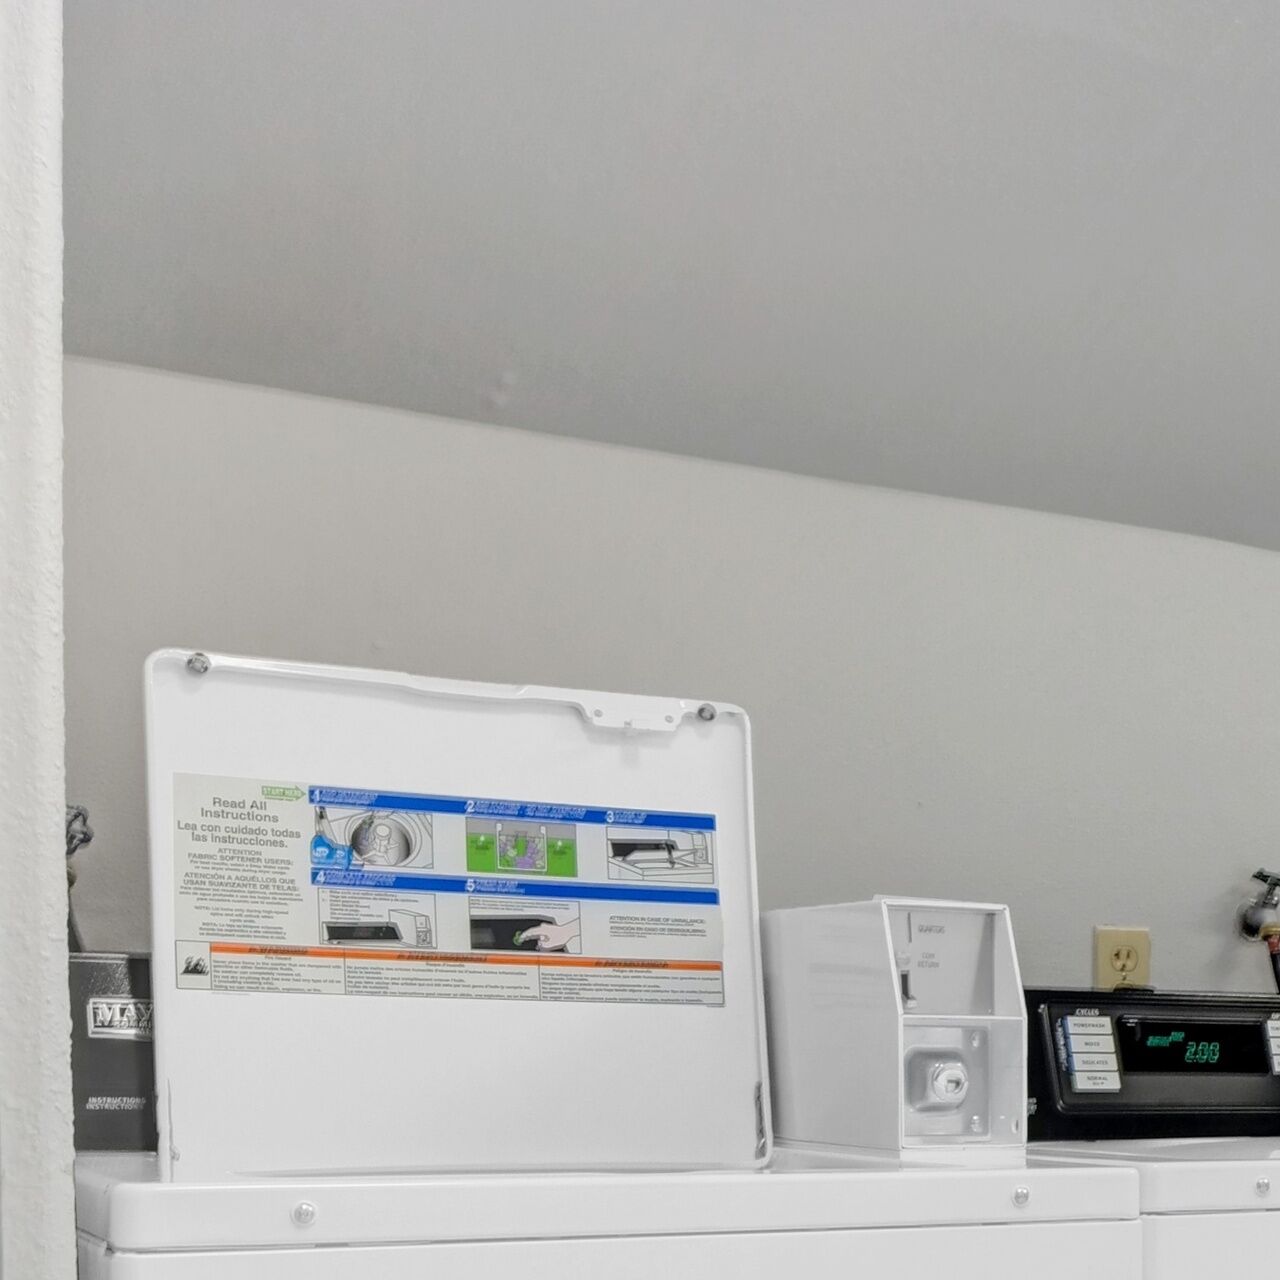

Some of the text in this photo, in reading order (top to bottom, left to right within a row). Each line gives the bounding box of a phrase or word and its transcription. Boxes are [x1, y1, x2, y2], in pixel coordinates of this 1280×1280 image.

[213, 797, 267, 811] Read All
[465, 800, 475, 813] 2
[200, 808, 279, 823] Instructions
[605, 811, 614, 822] 3
[177, 820, 301, 839] Lea con cuidado todas
[191, 832, 288, 848] las instrucciones.
[218, 848, 262, 856] ATTENTION
[188, 852, 294, 866] FABRIC SOFTENER USERS:
[184, 872, 225, 881] ATENCIÓN
[234, 874, 277, 884] AQUÉLLOS
[279, 877, 295, 885] QUE
[316, 870, 327, 883] 4
[183, 879, 206, 887] USAN
[208, 880, 258, 890] SUAVIZANTE
[465, 879, 475, 892] 5
[1076, 1008, 1100, 1016] CYCLES
[88, 1096, 146, 1104] INSTRUCTIONS
